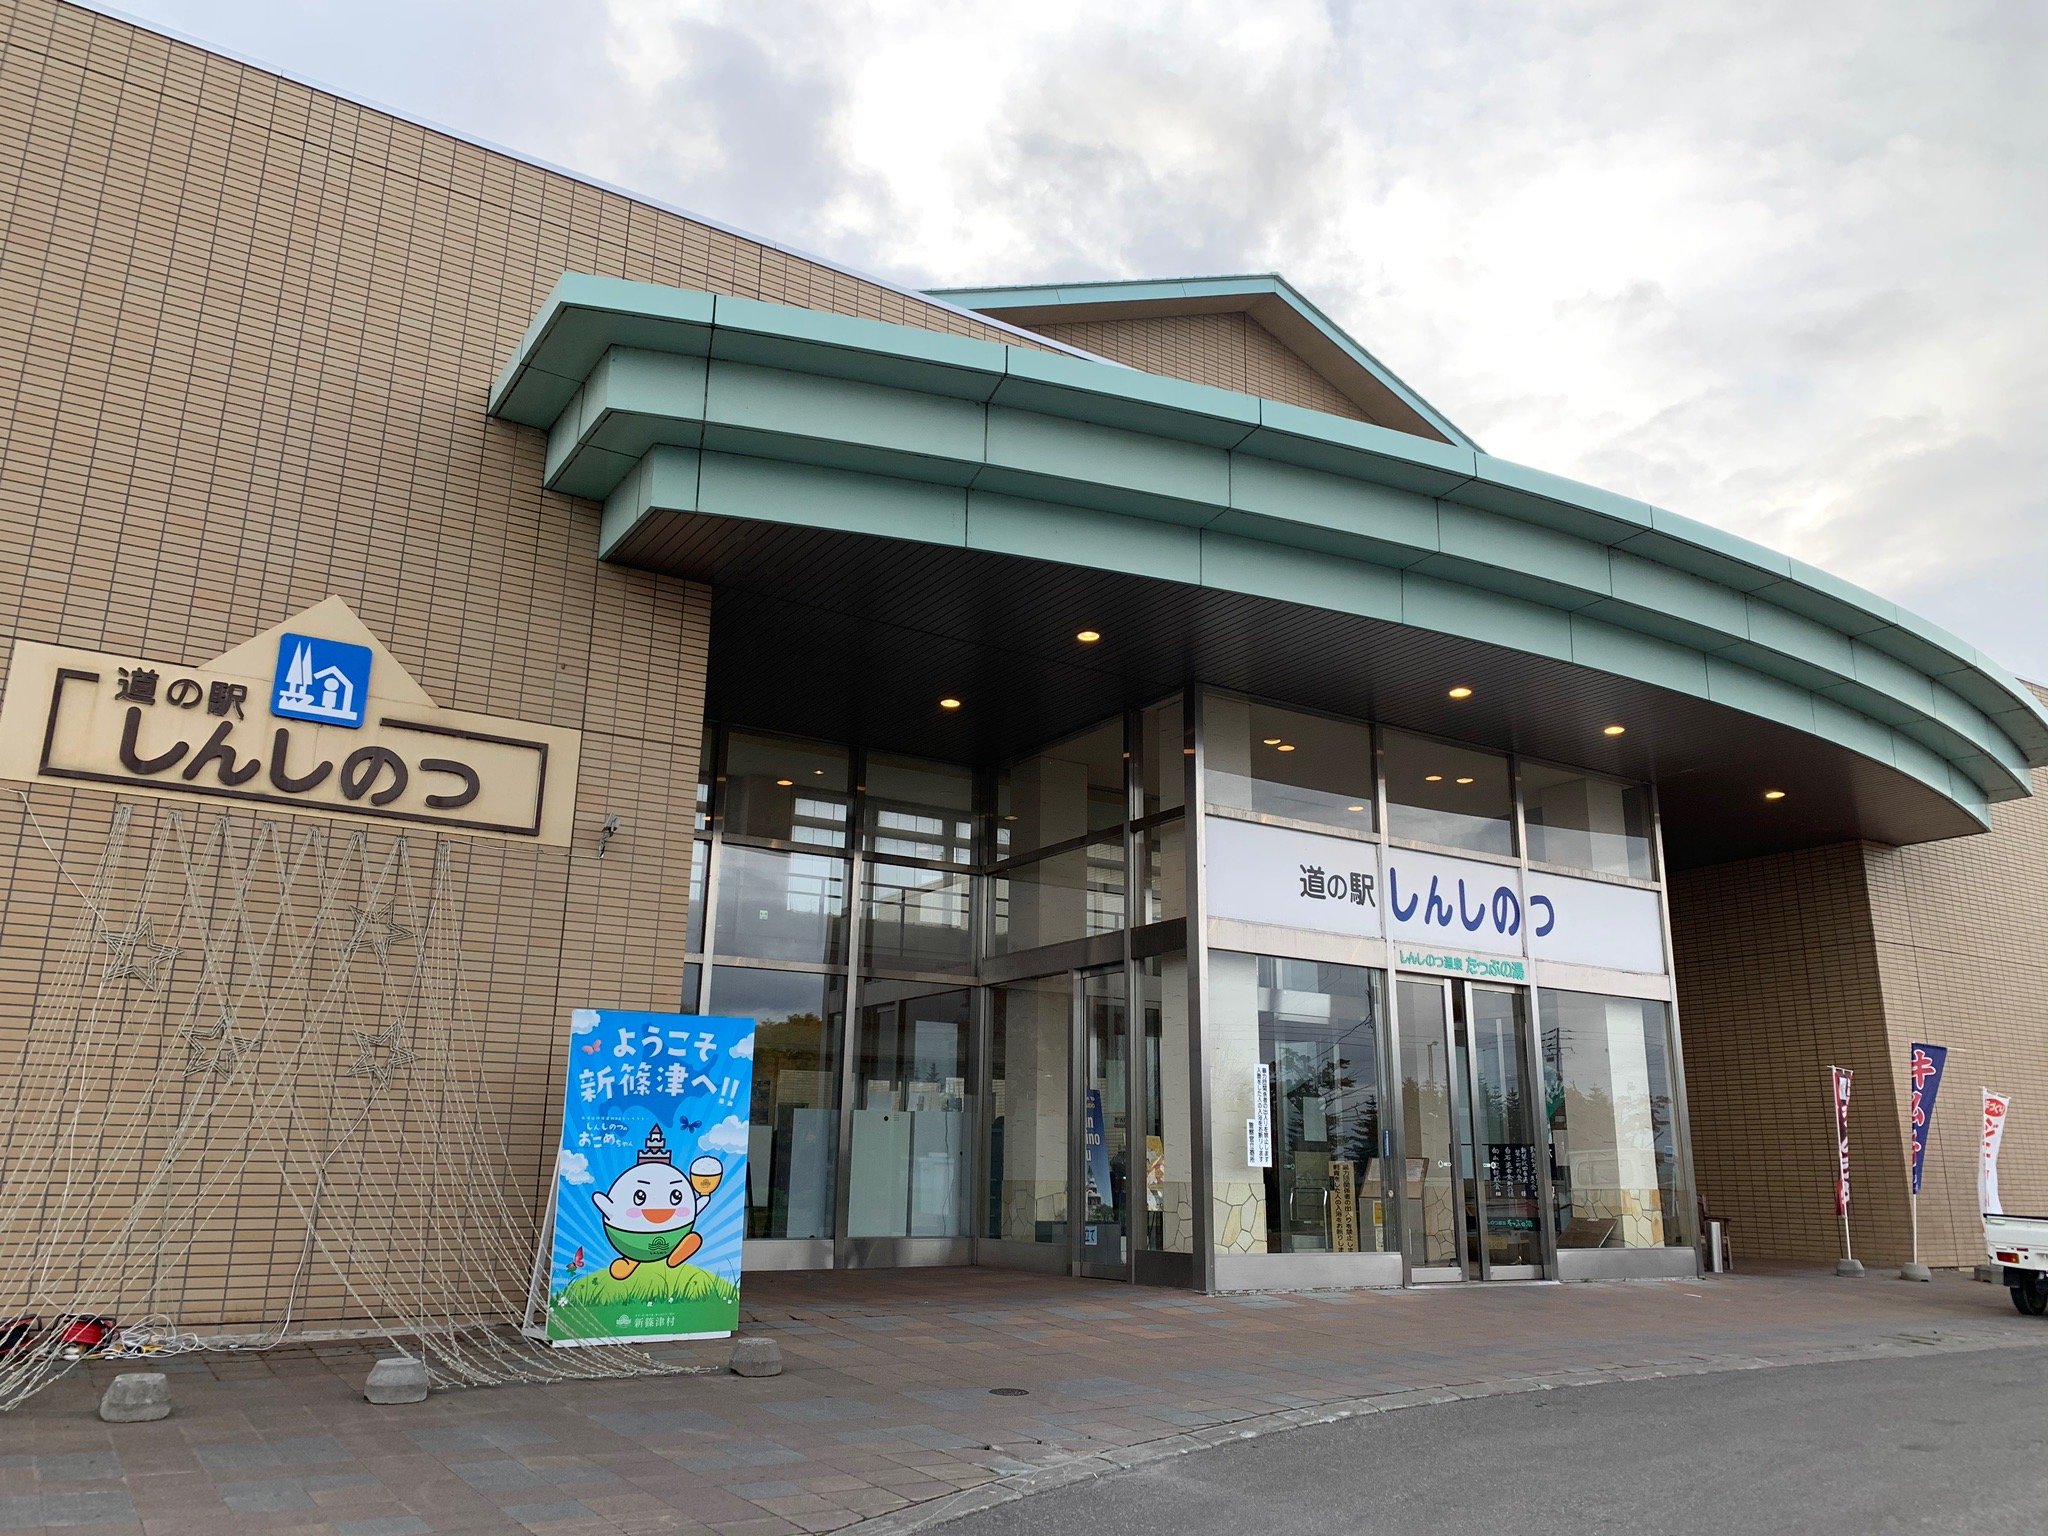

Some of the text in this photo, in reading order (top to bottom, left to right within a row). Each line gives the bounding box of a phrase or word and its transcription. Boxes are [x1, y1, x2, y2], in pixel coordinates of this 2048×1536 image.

[115, 667, 248, 720] 道の駅
[118, 706, 481, 810] しんしのつ
[1299, 864, 1556, 938] 道の駅 しんしのつ
[1399, 950, 1463, 971] しんしのつ温泉
[613, 1027, 718, 1063] ようこそ
[578, 1131, 634, 1149] おこめちゃん
[634, 1316, 675, 1328] 新篠津村
